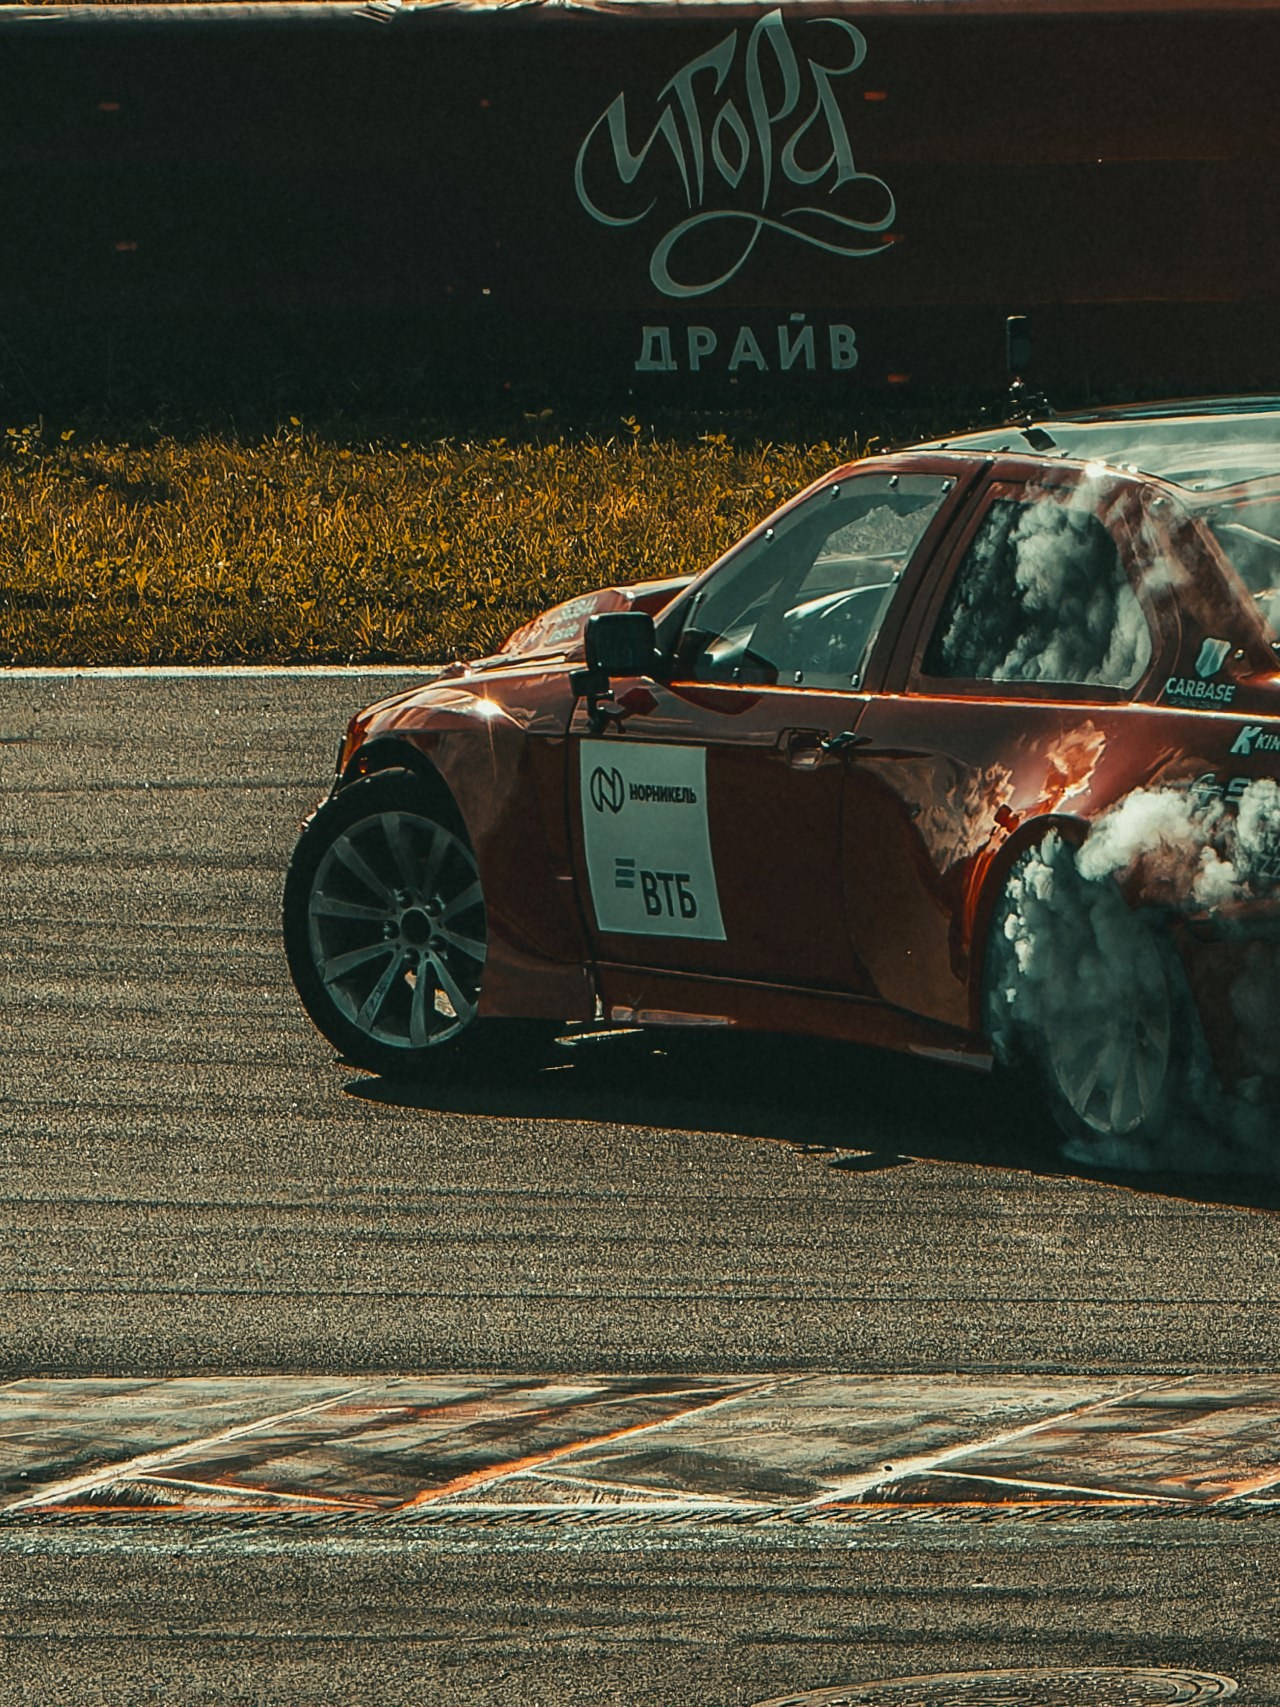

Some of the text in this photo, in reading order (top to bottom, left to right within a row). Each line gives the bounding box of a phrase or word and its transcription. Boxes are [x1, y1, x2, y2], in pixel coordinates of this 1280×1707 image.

[635, 313, 859, 371] ДРАЙВ
[1165, 677, 1236, 702] CARBASE
[629, 782, 697, 804] НОРНИКЕЛЬ
[640, 870, 697, 919] ВТБ
